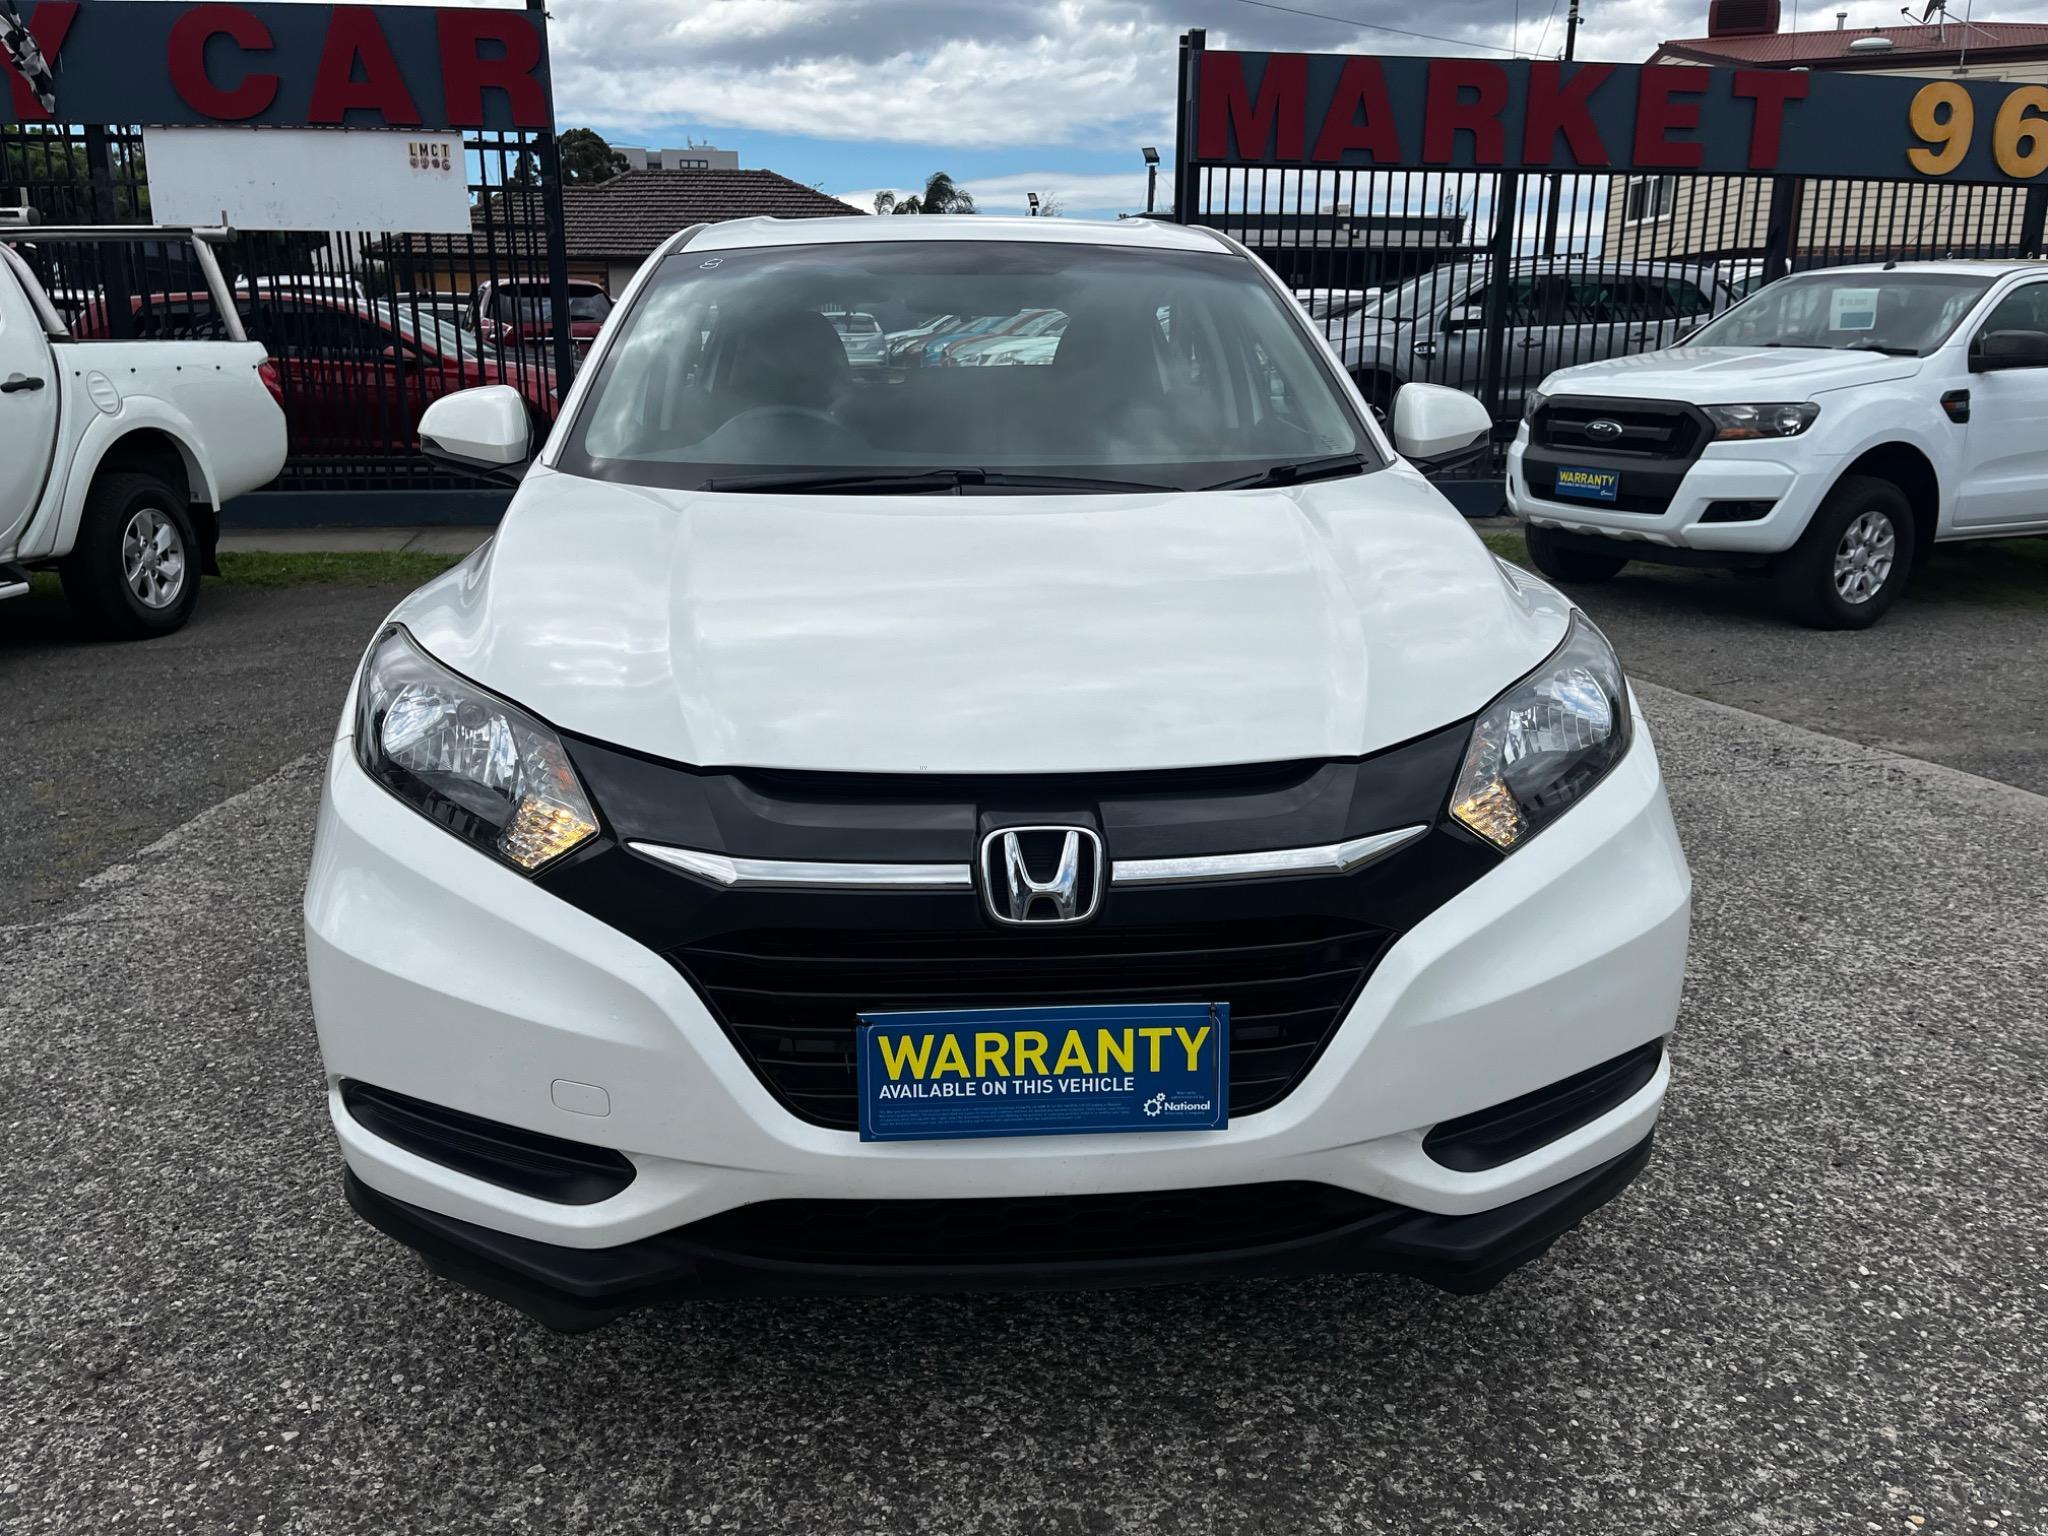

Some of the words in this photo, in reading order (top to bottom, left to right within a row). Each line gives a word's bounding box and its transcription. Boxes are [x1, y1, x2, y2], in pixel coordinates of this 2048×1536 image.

[168, 6, 550, 127] CAR
[1200, 52, 1809, 170] MARKET
[1907, 82, 2048, 179] 96
[409, 143, 449, 157] LMCT
[1560, 471, 1615, 486] WARRANTY
[878, 1026, 1211, 1081] WARRANTY
[879, 1082, 976, 1099] AVAILABLE
[982, 1081, 1007, 1095] ON
[1012, 1079, 1053, 1094] THIS
[1058, 1077, 1135, 1093] VEHICLE
[1164, 1100, 1211, 1111] National
